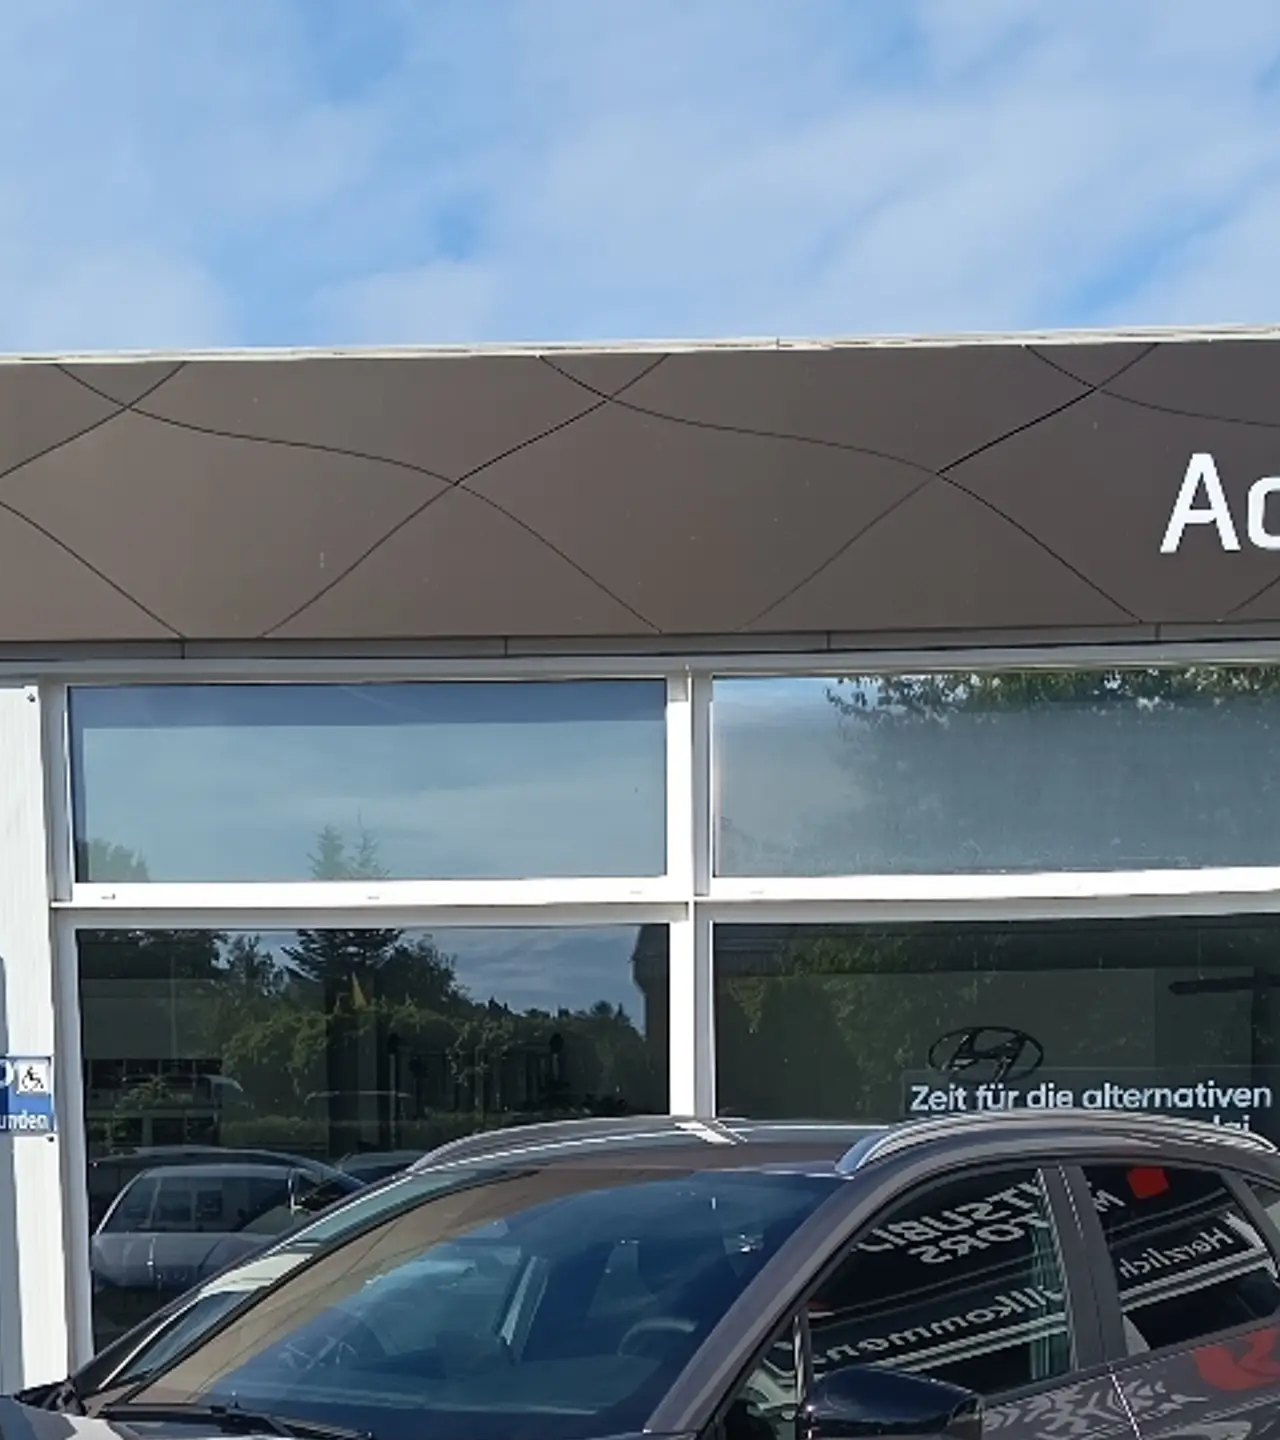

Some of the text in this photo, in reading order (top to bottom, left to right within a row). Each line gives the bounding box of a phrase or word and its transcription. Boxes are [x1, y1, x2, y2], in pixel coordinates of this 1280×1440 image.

[909, 1080, 1273, 1112] Zeit für die alternativen
